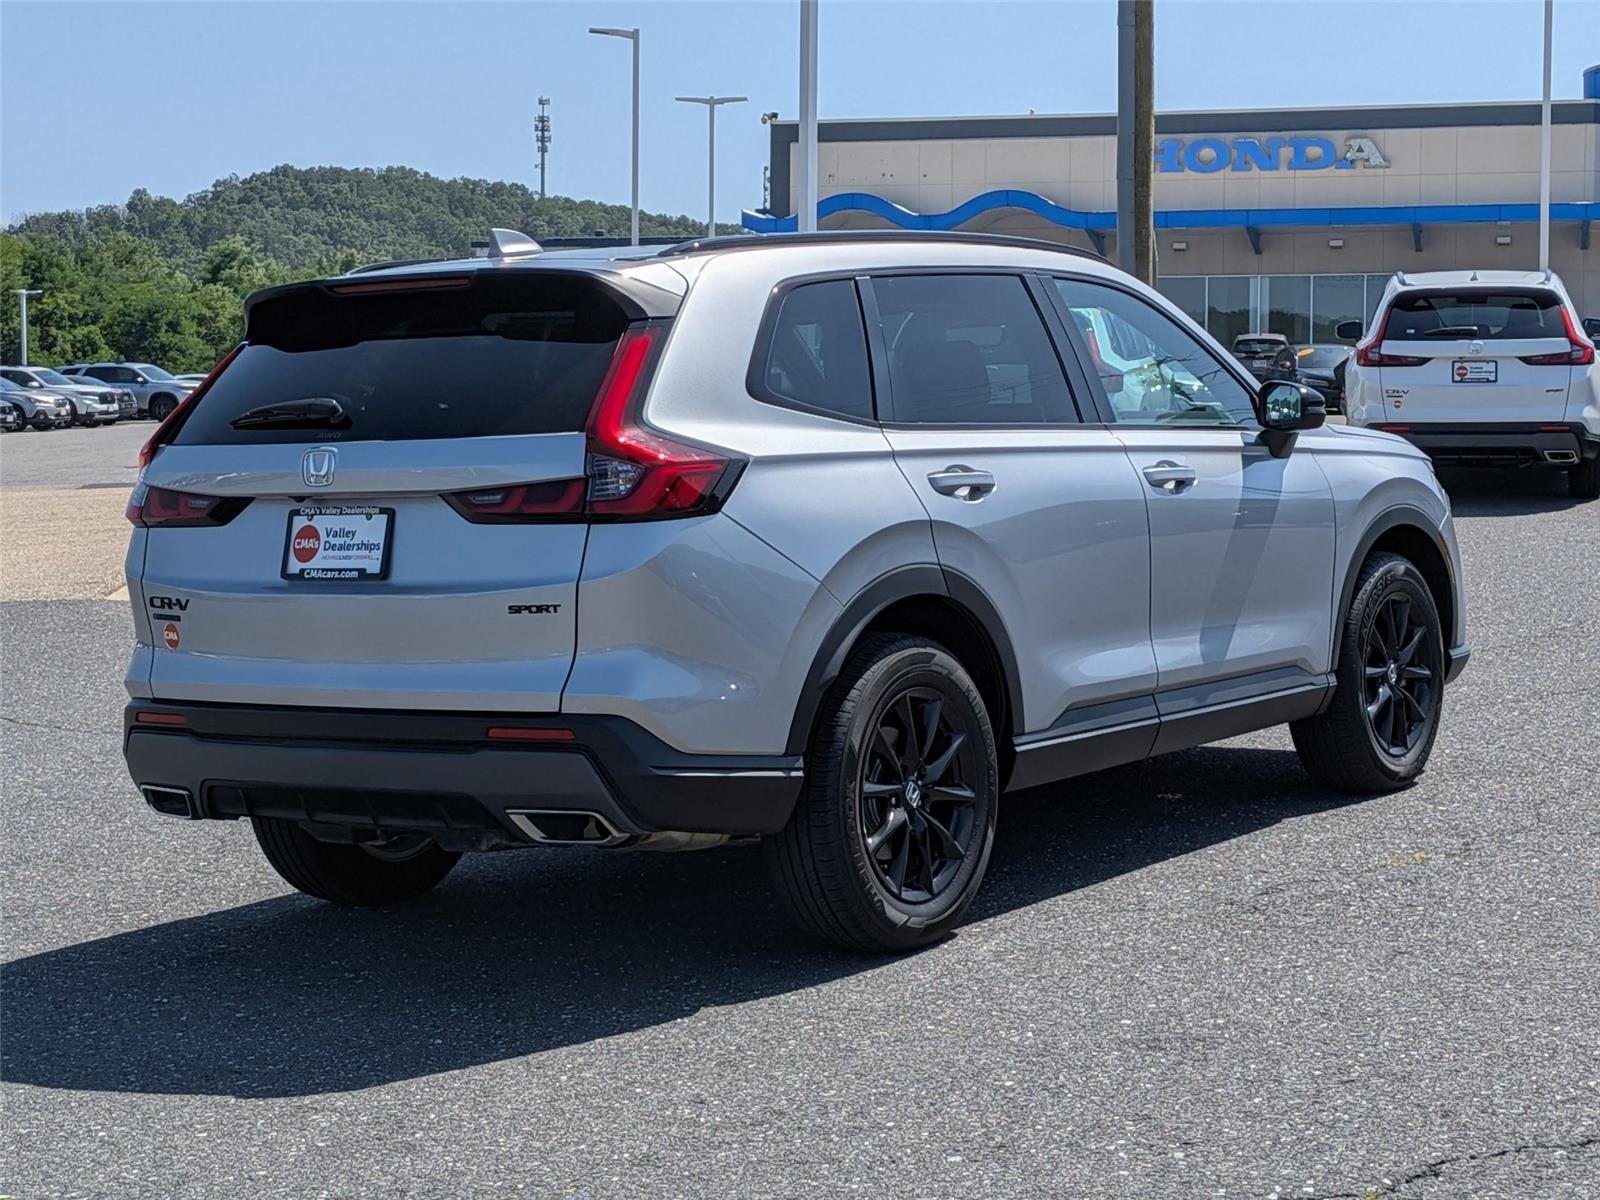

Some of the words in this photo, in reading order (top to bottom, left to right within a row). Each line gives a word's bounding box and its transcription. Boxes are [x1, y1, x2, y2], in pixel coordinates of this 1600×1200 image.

[321, 507, 340, 515] Valley
[342, 506, 379, 515] Dealerships
[325, 527, 357, 539] Valley
[294, 538, 320, 549] CMA's
[323, 540, 381, 553] Dealerships
[304, 569, 358, 579] CMAcars.com
[149, 596, 190, 611] CR-V
[508, 604, 561, 614] SPORT
